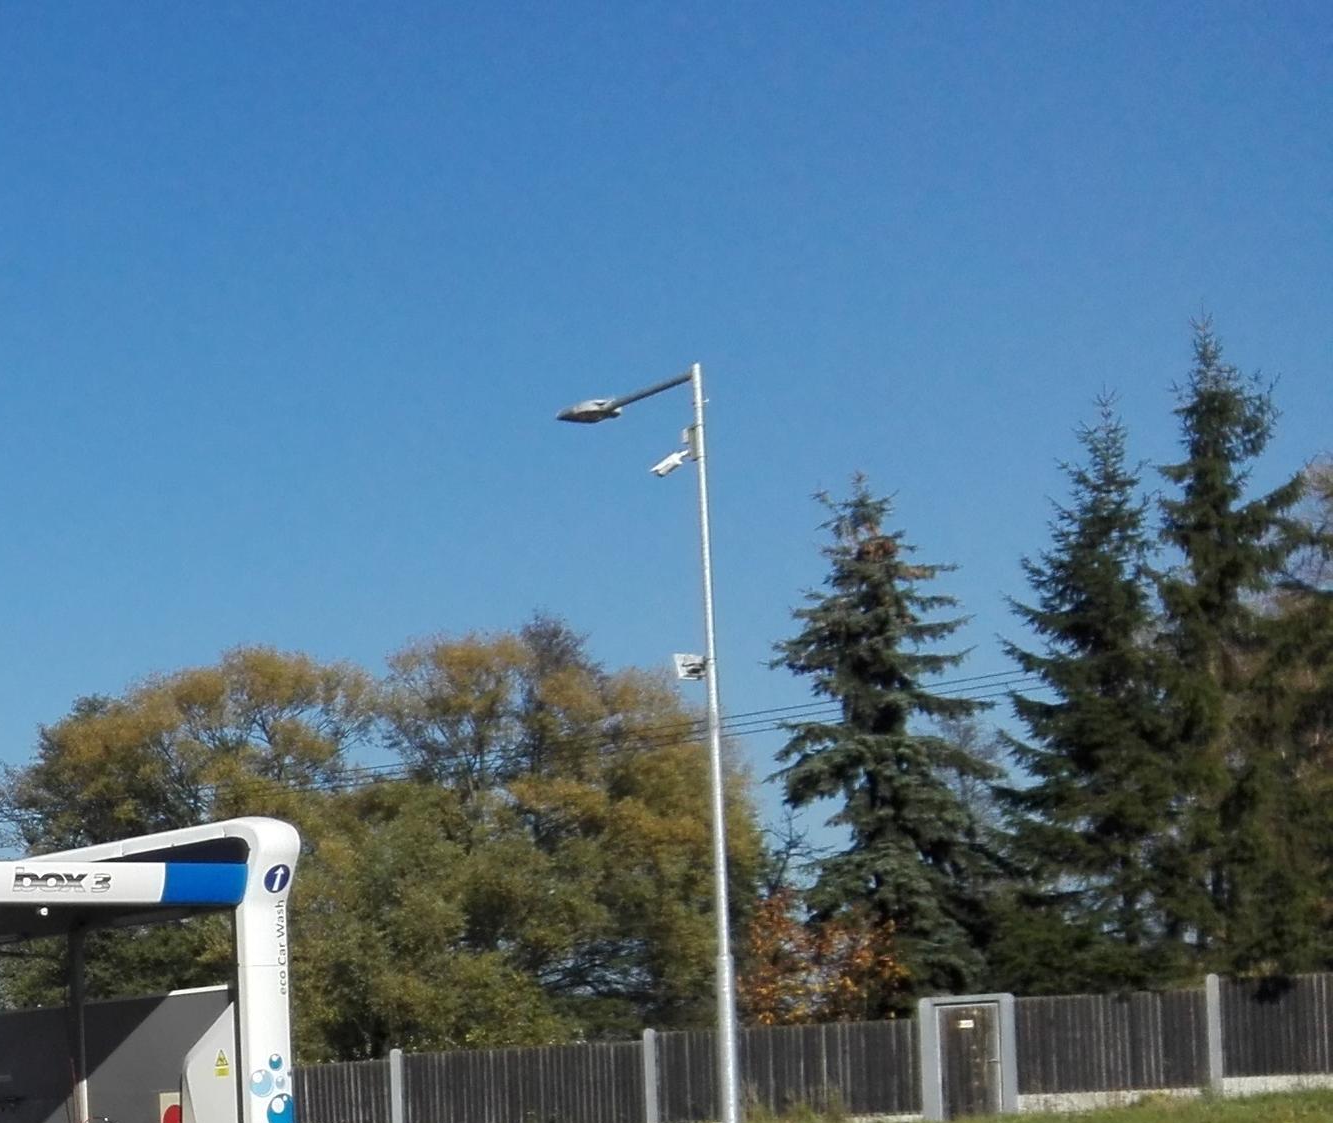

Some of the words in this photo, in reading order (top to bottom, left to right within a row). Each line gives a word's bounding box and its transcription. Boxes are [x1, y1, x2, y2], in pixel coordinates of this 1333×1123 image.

[13, 867, 88, 892] box
[91, 873, 111, 893] 3
[275, 899, 284, 938] Wash
[277, 943, 286, 966] Car
[278, 970, 286, 995] eco
